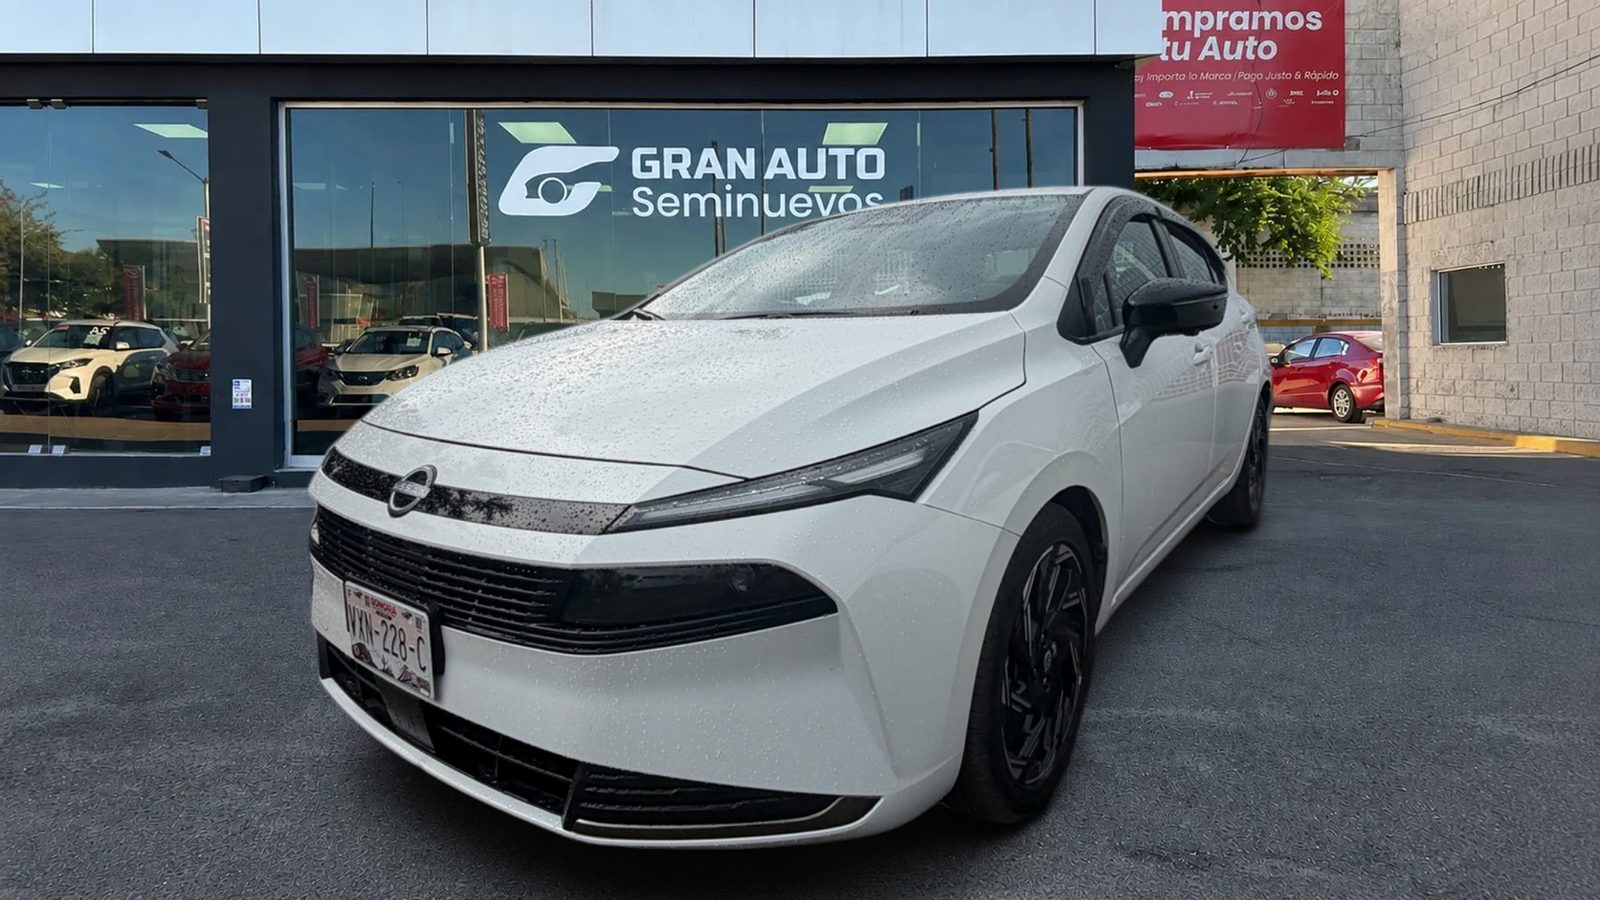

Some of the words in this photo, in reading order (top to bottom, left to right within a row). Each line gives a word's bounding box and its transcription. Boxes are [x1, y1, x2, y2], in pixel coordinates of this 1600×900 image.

[1162, 10, 1323, 37] mpramos
[1160, 37, 1191, 61] tu
[1197, 36, 1278, 61] Auto
[1146, 73, 1186, 83] Importa
[1200, 72, 1232, 81] Marca
[1265, 72, 1292, 80] Justo
[631, 147, 756, 180] GRAN
[763, 147, 886, 180] AUTO
[632, 184, 884, 218] Seminuevos
[347, 604, 427, 672] VXN-228-C
